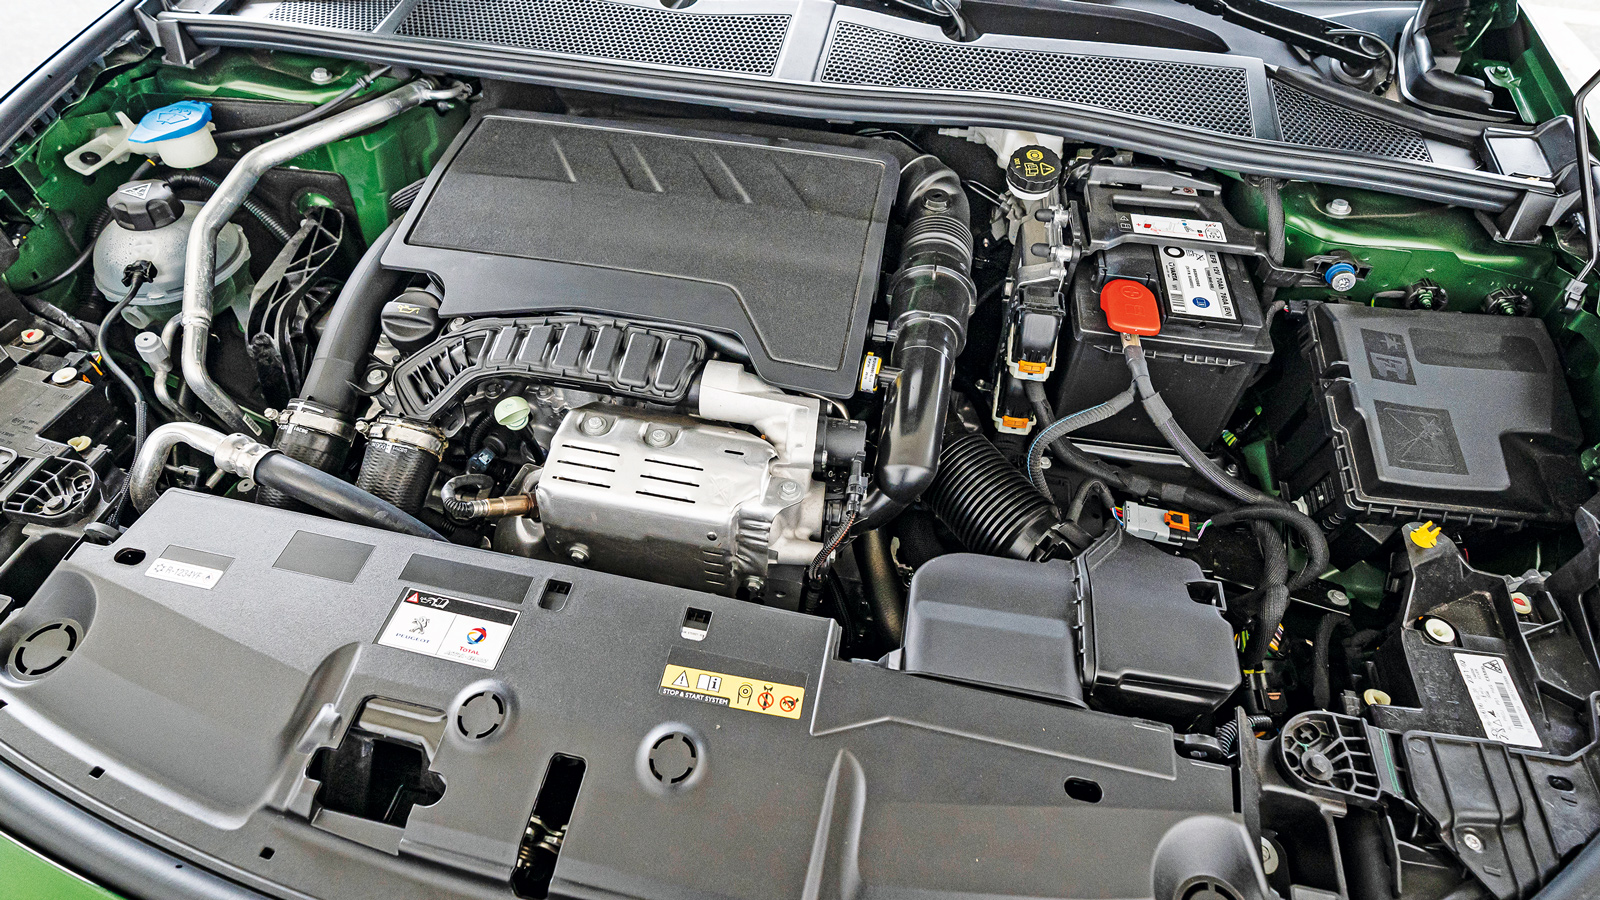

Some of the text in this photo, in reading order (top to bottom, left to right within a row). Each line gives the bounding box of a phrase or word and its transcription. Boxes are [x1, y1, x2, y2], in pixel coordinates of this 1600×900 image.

[166, 566, 203, 579] R-1234YF
[395, 632, 430, 643] PEUGEOT
[663, 688, 679, 696] STOP
[685, 692, 704, 701] START
[705, 695, 728, 705] SYSTEM
